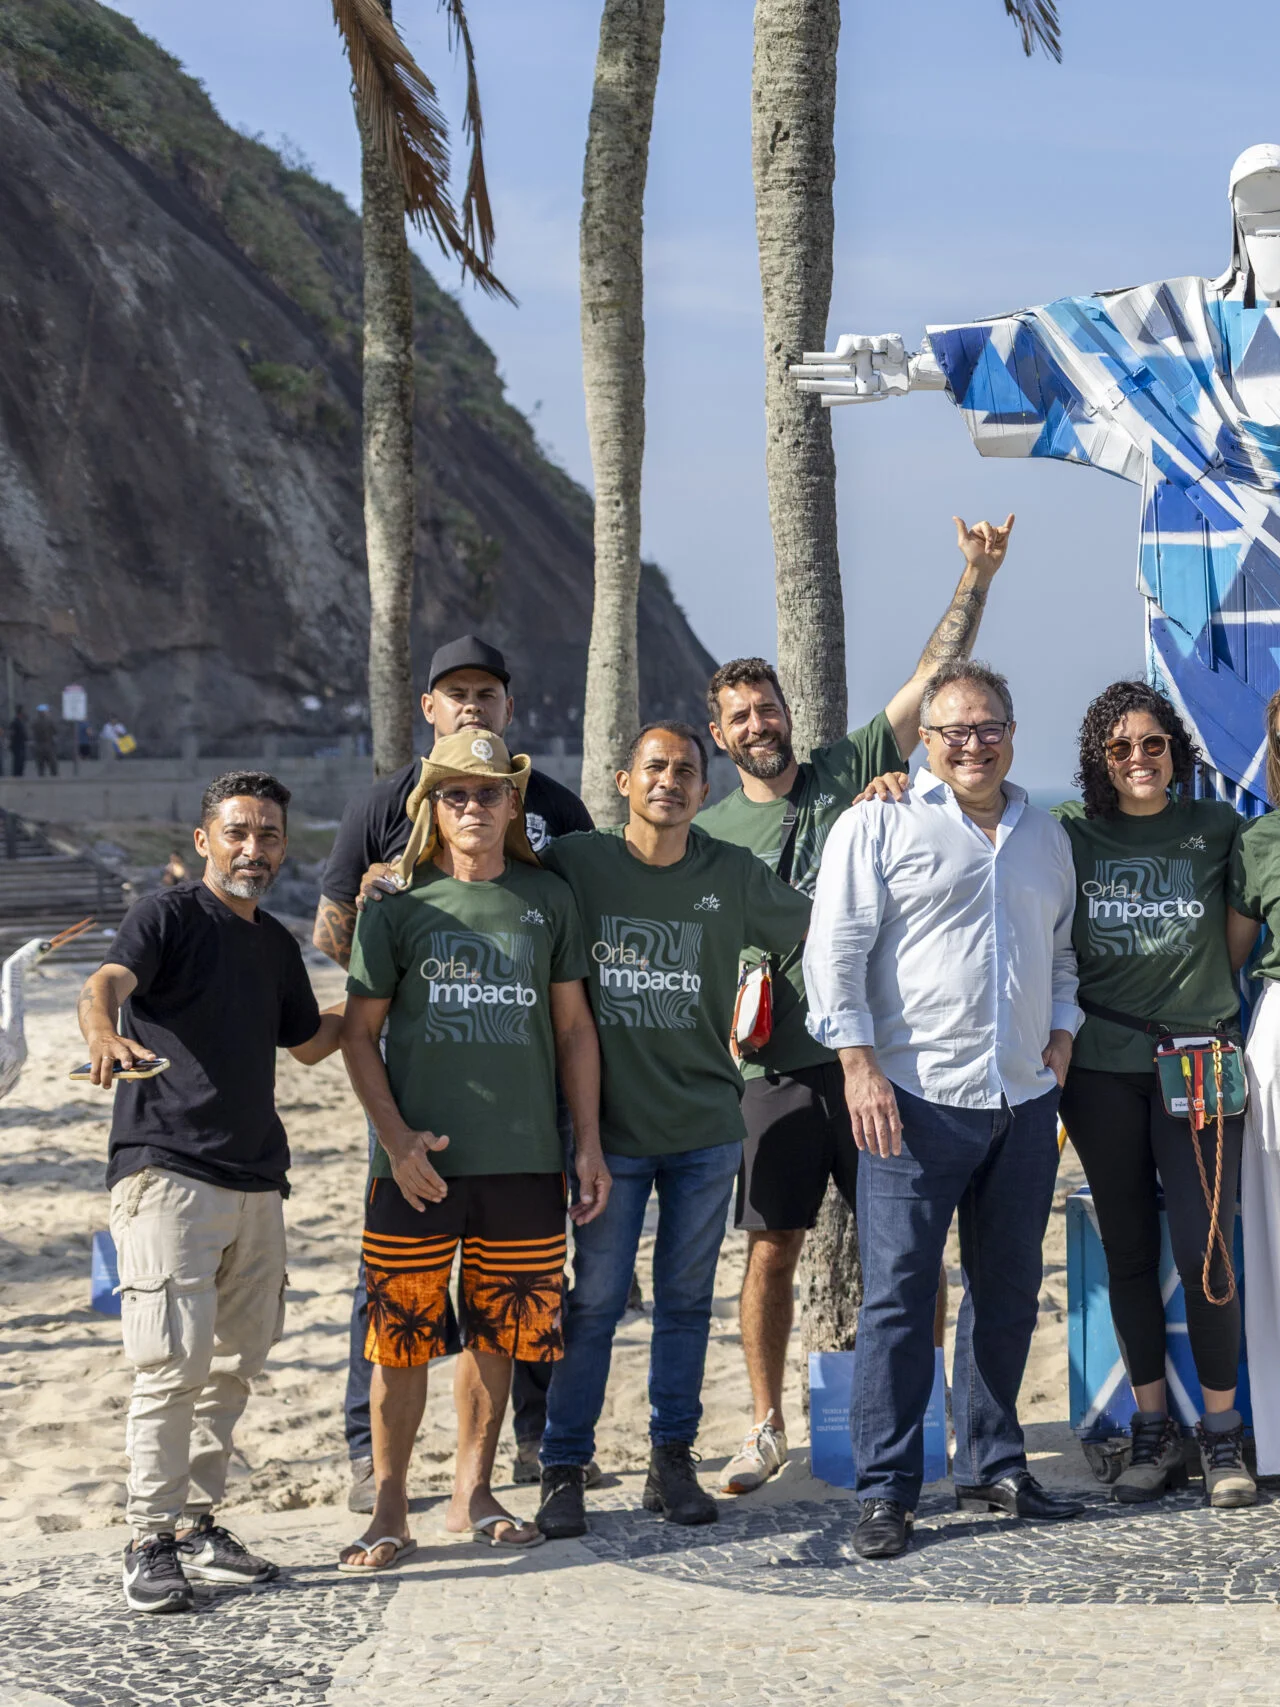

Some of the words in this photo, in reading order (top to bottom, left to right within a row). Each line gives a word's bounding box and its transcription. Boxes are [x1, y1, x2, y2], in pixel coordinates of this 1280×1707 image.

[1082, 880, 1128, 899] Orla
[1088, 896, 1205, 923] Impacto
[592, 941, 636, 965] Orla
[420, 956, 467, 980] Orla
[599, 964, 702, 994] Impacto
[429, 981, 537, 1009] Impacto
